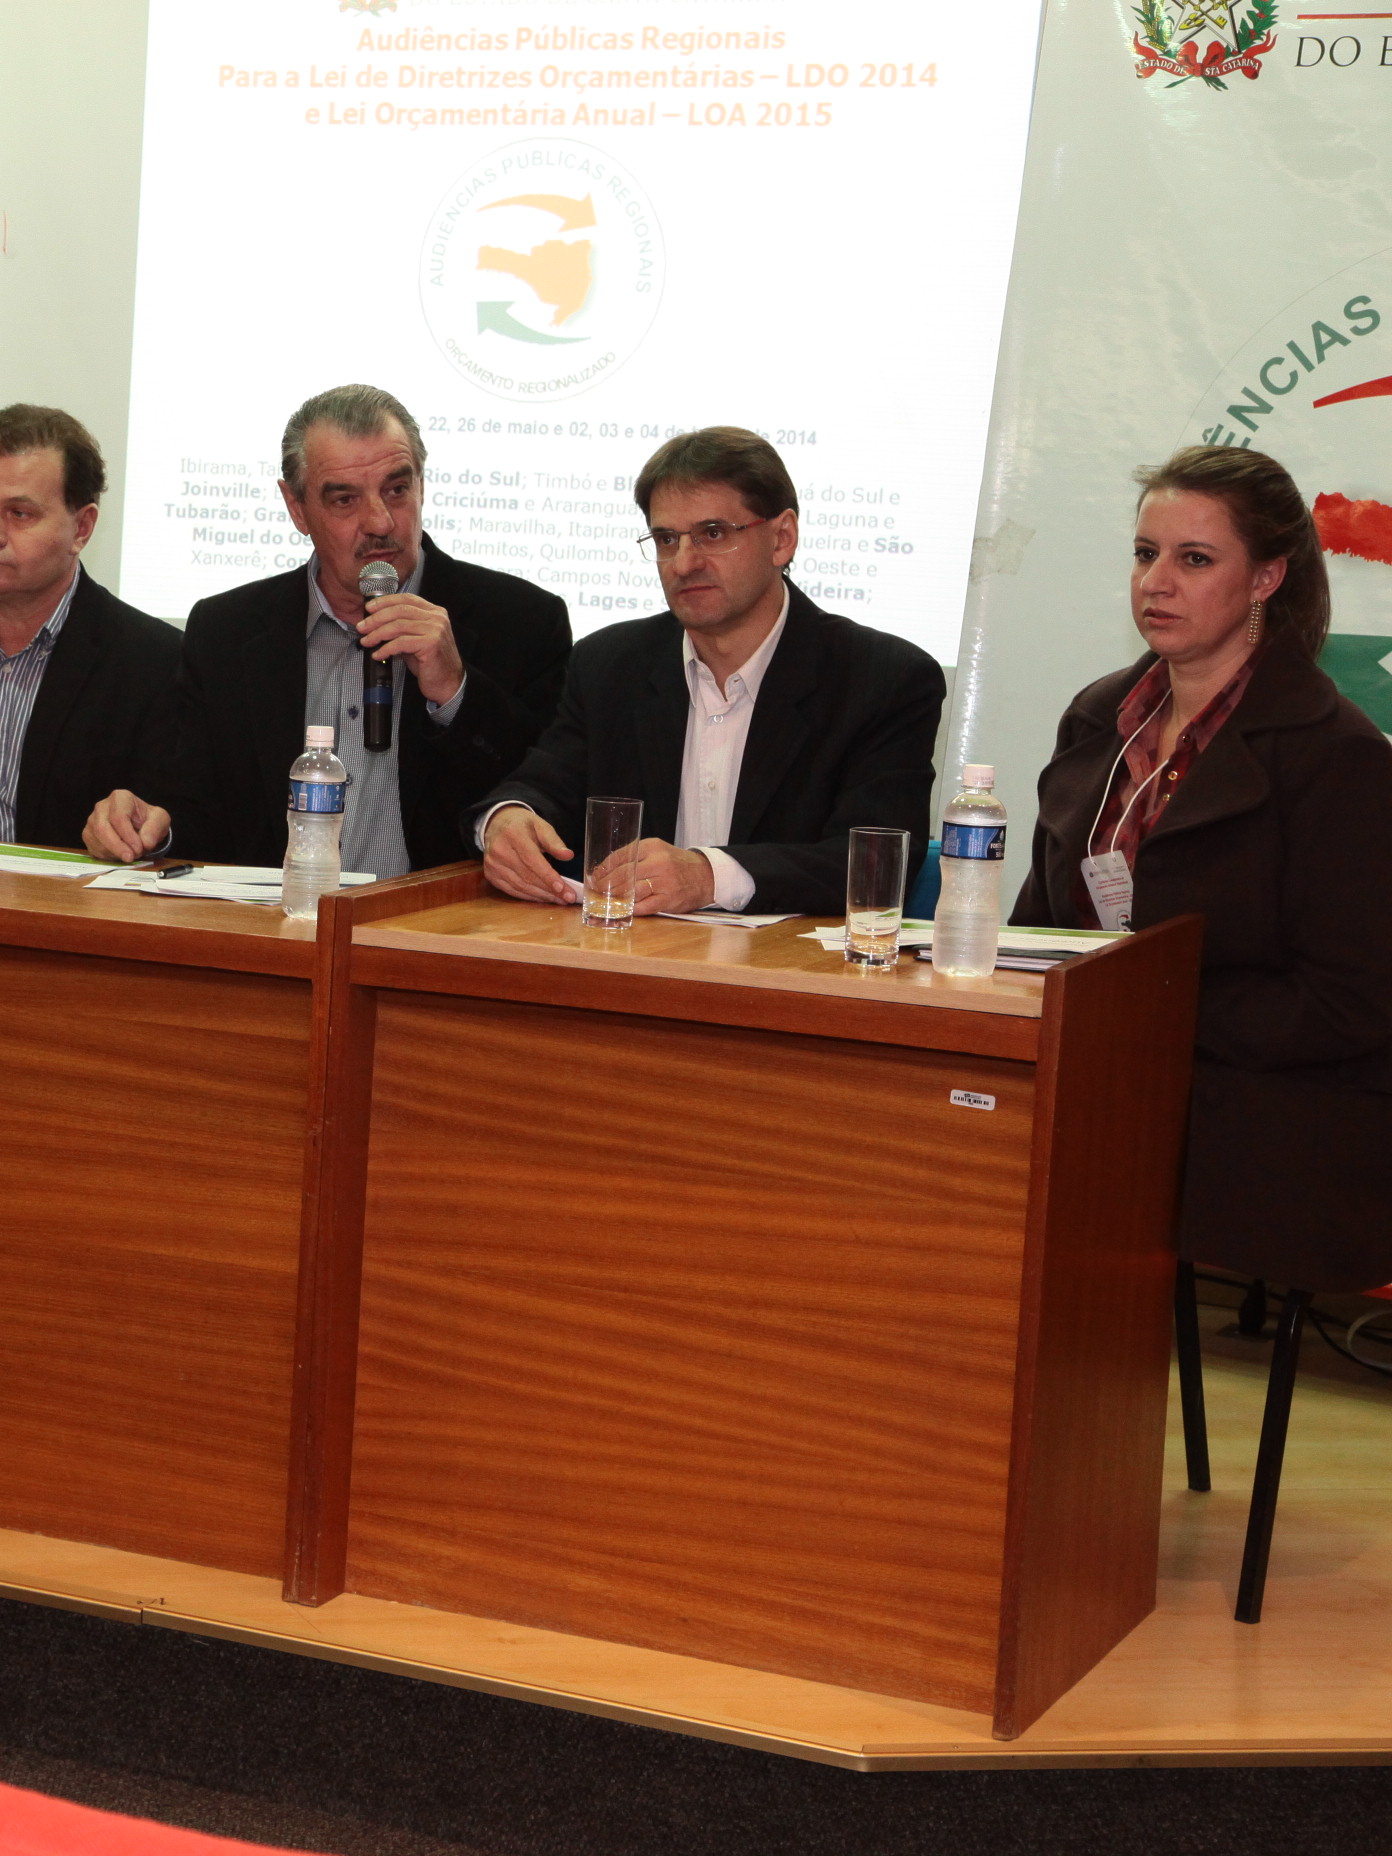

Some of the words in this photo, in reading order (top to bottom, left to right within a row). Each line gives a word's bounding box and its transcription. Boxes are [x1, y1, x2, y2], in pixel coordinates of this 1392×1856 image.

[356, 25, 509, 52] Audiências
[515, 24, 634, 52] Públicas
[641, 24, 786, 55] Regionais
[1295, 35, 1362, 68] DO
[218, 64, 278, 88] Para
[285, 69, 300, 88] a
[309, 64, 347, 88] Lei
[355, 64, 388, 88] de
[397, 64, 533, 88] Diretrizes
[539, 61, 755, 94] Orçamentárias
[786, 63, 850, 88] LDO
[859, 62, 939, 88] 2014
[1222, 58, 1259, 72] CATARINA
[305, 107, 320, 126] e
[328, 101, 366, 126] Lei
[375, 100, 566, 131] Orçamentária
[572, 102, 657, 126] Anual
[688, 102, 747, 126] LOA
[756, 102, 833, 126] 2015
[607, 175, 654, 294] REGIONAIS
[445, 337, 514, 390] ORÇAMENTO
[518, 351, 616, 394] REGIONALIZADO
[1201, 295, 1381, 449] ÊNCIAS
[428, 416, 451, 433] 22,
[457, 417, 476, 432] 26
[482, 418, 502, 434] de
[508, 420, 549, 435] maio
[553, 424, 563, 436] e
[569, 421, 593, 440] 02,
[599, 422, 619, 438] 03
[625, 425, 635, 438] e
[640, 424, 659, 439] 04
[776, 429, 817, 446] 2014
[180, 458, 251, 478] Ibirama,
[424, 467, 452, 484] Rio
[458, 468, 483, 485] do
[488, 470, 528, 489] Sul;
[534, 472, 592, 491] Timbó
[596, 478, 608, 492] e
[820, 485, 846, 502] do
[852, 487, 884, 504] Sul
[889, 491, 901, 505] e
[164, 503, 248, 525] Tubarão;
[469, 516, 562, 538] Maravilha,
[858, 539, 869, 552] e
[873, 535, 914, 555] São
[180, 481, 268, 500] Joinville;
[432, 490, 519, 510] Criciúma
[525, 498, 535, 511] e
[805, 510, 879, 530] Laguna
[884, 516, 895, 529] e
[191, 526, 255, 546] Miguel
[259, 529, 283, 546] do
[452, 539, 534, 561] Palmitos,
[540, 543, 634, 566] Quilombo,
[803, 557, 860, 577] Oeste
[866, 564, 878, 577] e
[190, 549, 268, 570] Xanxerê;
[537, 567, 611, 588] Campos
[798, 581, 872, 605] ideira;
[578, 591, 638, 612] Lages
[642, 598, 654, 611] e
